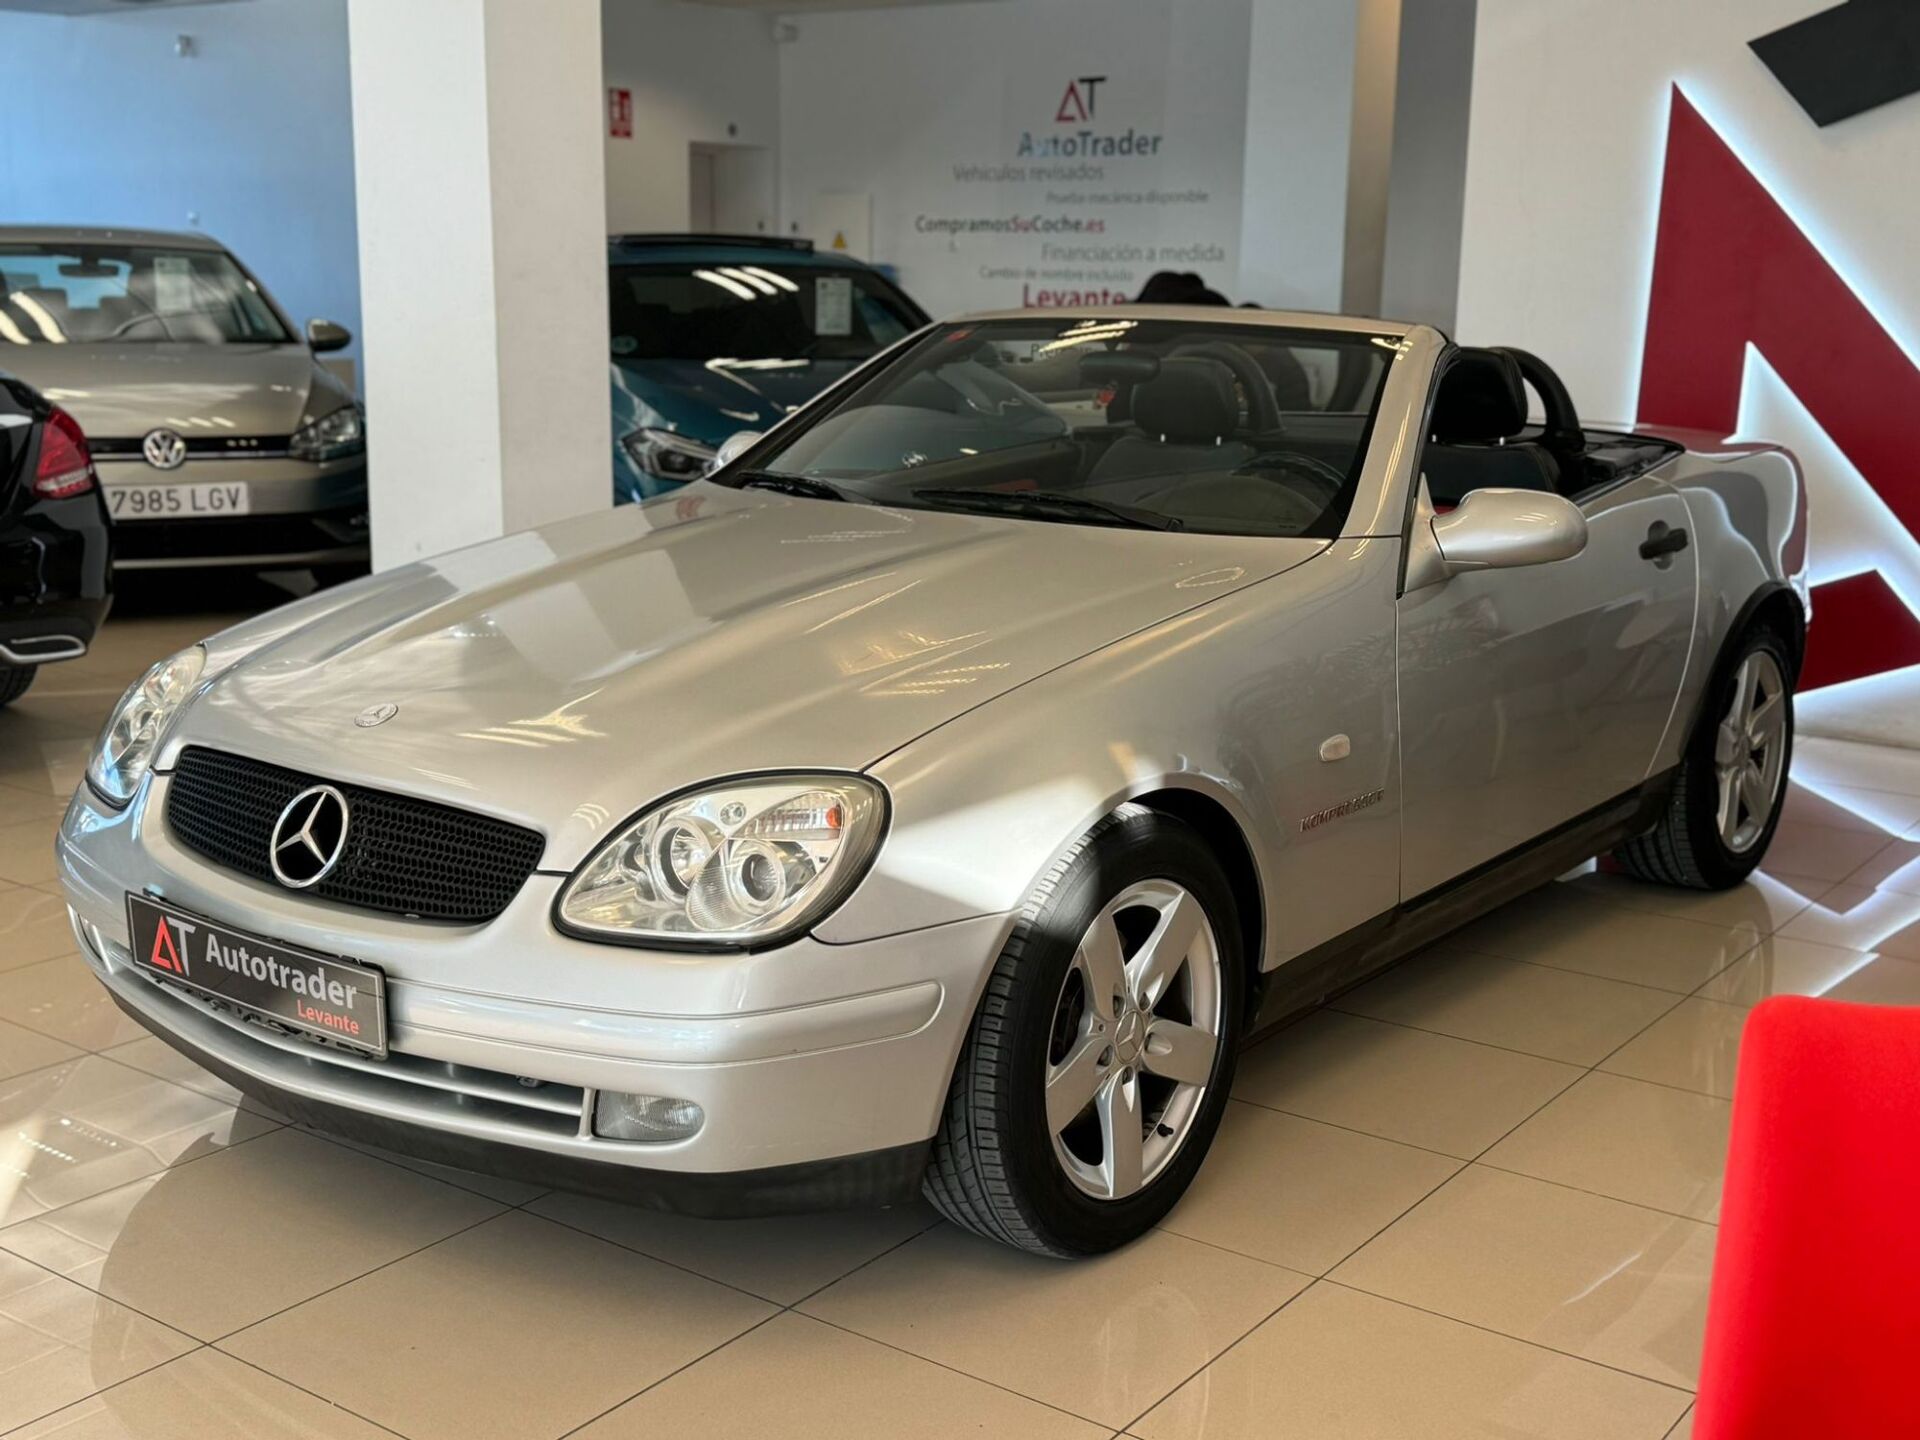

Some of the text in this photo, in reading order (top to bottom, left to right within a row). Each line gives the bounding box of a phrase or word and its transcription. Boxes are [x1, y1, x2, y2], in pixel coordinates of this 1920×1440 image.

[1029, 164, 1104, 181] revisados
[914, 215, 1105, 235] CompramosSuCoche.es
[1145, 248, 1156, 262] a
[1159, 243, 1225, 262] medida
[111, 486, 241, 514] 7985 LGV
[206, 934, 357, 1008] Autotrader
[296, 999, 360, 1036] Levante
